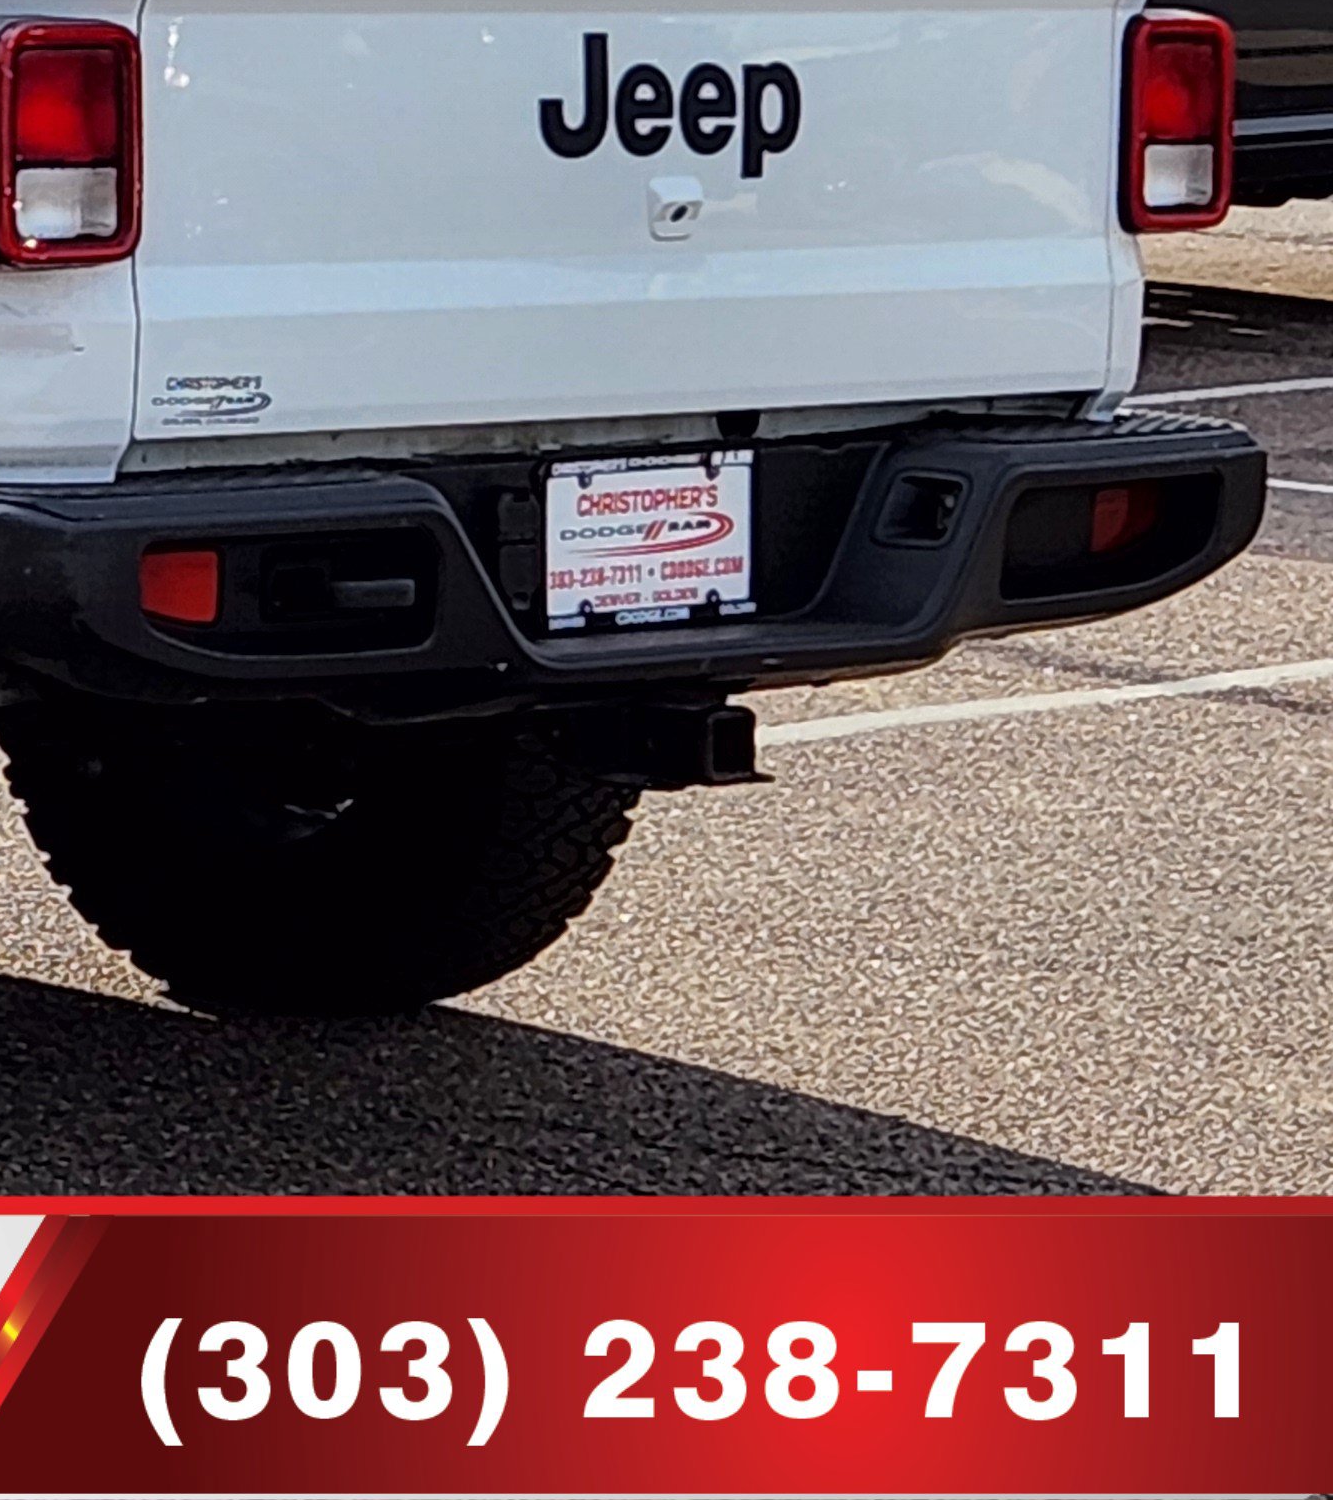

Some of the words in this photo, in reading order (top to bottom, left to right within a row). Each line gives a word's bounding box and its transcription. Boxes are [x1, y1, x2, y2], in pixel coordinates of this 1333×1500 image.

[538, 32, 802, 179] Jeep
[577, 484, 719, 517] CHRISTOPHER'S
[560, 525, 647, 541] DODGE
[668, 519, 711, 533] RAM
